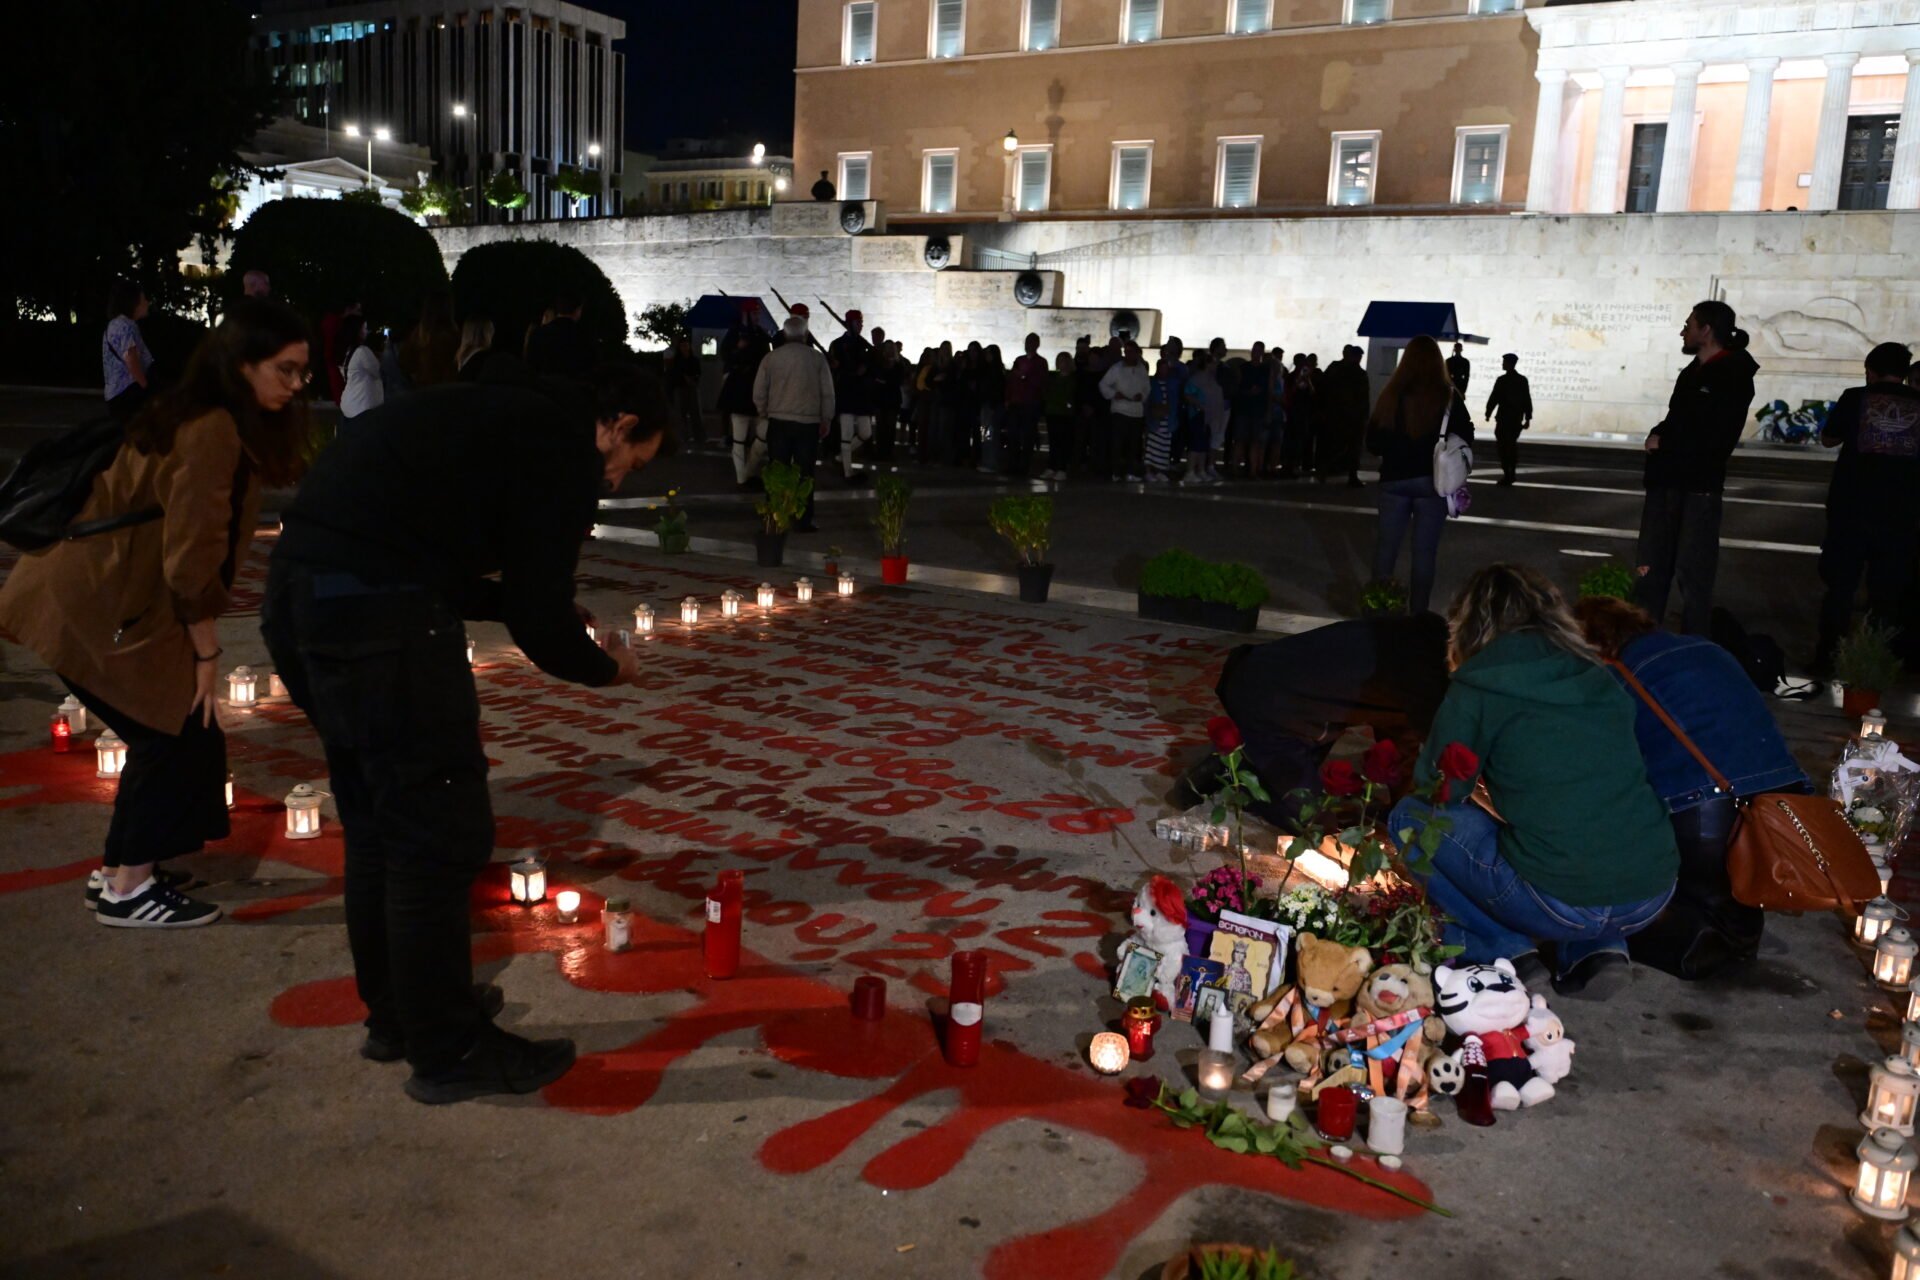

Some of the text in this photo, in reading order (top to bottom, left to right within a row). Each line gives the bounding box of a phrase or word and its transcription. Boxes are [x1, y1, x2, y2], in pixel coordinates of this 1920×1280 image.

[843, 720, 962, 748] 28
[803, 776, 944, 816] 28
[994, 792, 1135, 835] 28
[620, 759, 1128, 913] Χατζηχαραλάμπο
